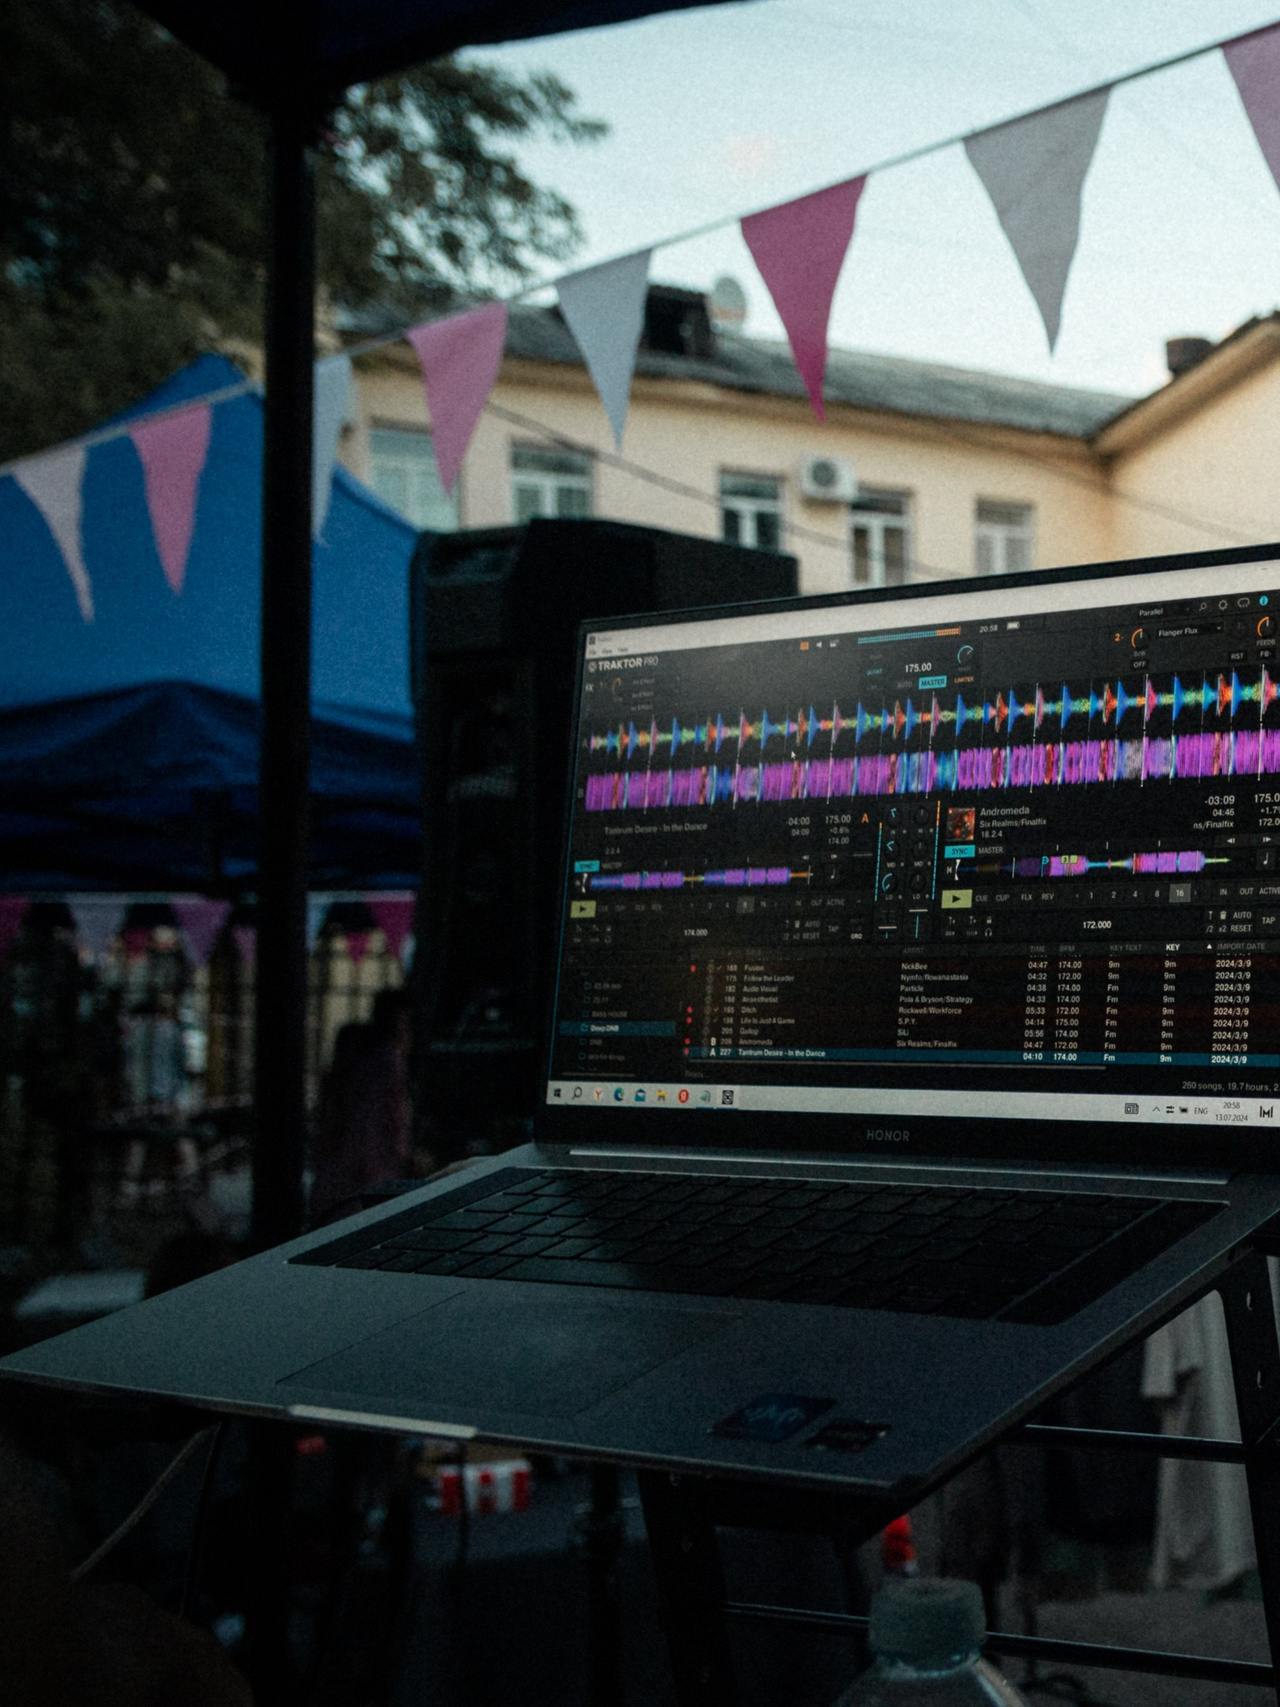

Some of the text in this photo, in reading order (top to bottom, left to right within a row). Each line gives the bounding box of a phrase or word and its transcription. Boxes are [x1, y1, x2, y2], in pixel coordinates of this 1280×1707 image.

[1139, 608, 1164, 617] Parallel
[979, 624, 998, 633] 20:58
[1158, 627, 1198, 638] Flanger Flux
[1230, 652, 1244, 660] RST
[598, 655, 659, 672] TRAKTOR PRO
[905, 662, 932, 673] 175.00
[1133, 661, 1146, 669] OFF
[921, 678, 945, 687] MASTER
[1204, 795, 1235, 805] -03:09
[980, 806, 1030, 817] Andromeda
[1212, 808, 1235, 817] 04:46
[786, 816, 810, 826] -04:00
[825, 815, 851, 824] 175.00
[861, 813, 869, 824] A
[980, 820, 991, 829] Six
[604, 826, 634, 836] Tantrum
[671, 823, 683, 832] the
[684, 822, 708, 832] Dance
[981, 830, 1003, 839] 18.2.4
[828, 837, 850, 846] 174.00
[978, 846, 1003, 854] MASTER
[1220, 888, 1227, 896] IN
[1239, 887, 1253, 895] OUT
[1021, 893, 1033, 901] FLX
[1042, 893, 1055, 901] REV
[1232, 911, 1252, 919] AUTO
[1262, 917, 1276, 925] TAP
[1083, 921, 1112, 930] 172.000
[1230, 924, 1252, 932] RESET
[901, 962, 928, 970] NickBee
[1058, 961, 1082, 969] 174.00
[1216, 960, 1251, 968] 2024/3/9
[1215, 972, 1251, 980] 2024/3/9
[1057, 984, 1081, 992] 174.00
[1163, 984, 1175, 992] 9m
[1215, 984, 1250, 992] 2024/3/9
[1214, 996, 1250, 1004] 2024/3/9
[1025, 1007, 1045, 1015] 05:33
[1056, 1007, 1080, 1015] 172.00
[1214, 1008, 1249, 1016] 2024/3/9
[1213, 1019, 1249, 1028] 2024/3/9
[1055, 1030, 1078, 1038] 174.00
[1161, 1031, 1173, 1039] 9m
[1212, 1031, 1248, 1040] 2024/3/9
[896, 1040, 907, 1048] Six
[1161, 1043, 1172, 1051] 9m
[1212, 1043, 1248, 1052] 2024/3/9
[1211, 1055, 1247, 1064] 2024/3/9
[1182, 1081, 1196, 1090] 260
[1198, 1083, 1225, 1092] songs,
[1228, 1082, 1244, 1091] 19.7
[1245, 1083, 1272, 1092] hours,
[1223, 1102, 1240, 1110] 20:58
[1194, 1107, 1208, 1115] ENG
[1215, 1114, 1248, 1122] 13.07.2024
[866, 1129, 910, 1142] HONOR
